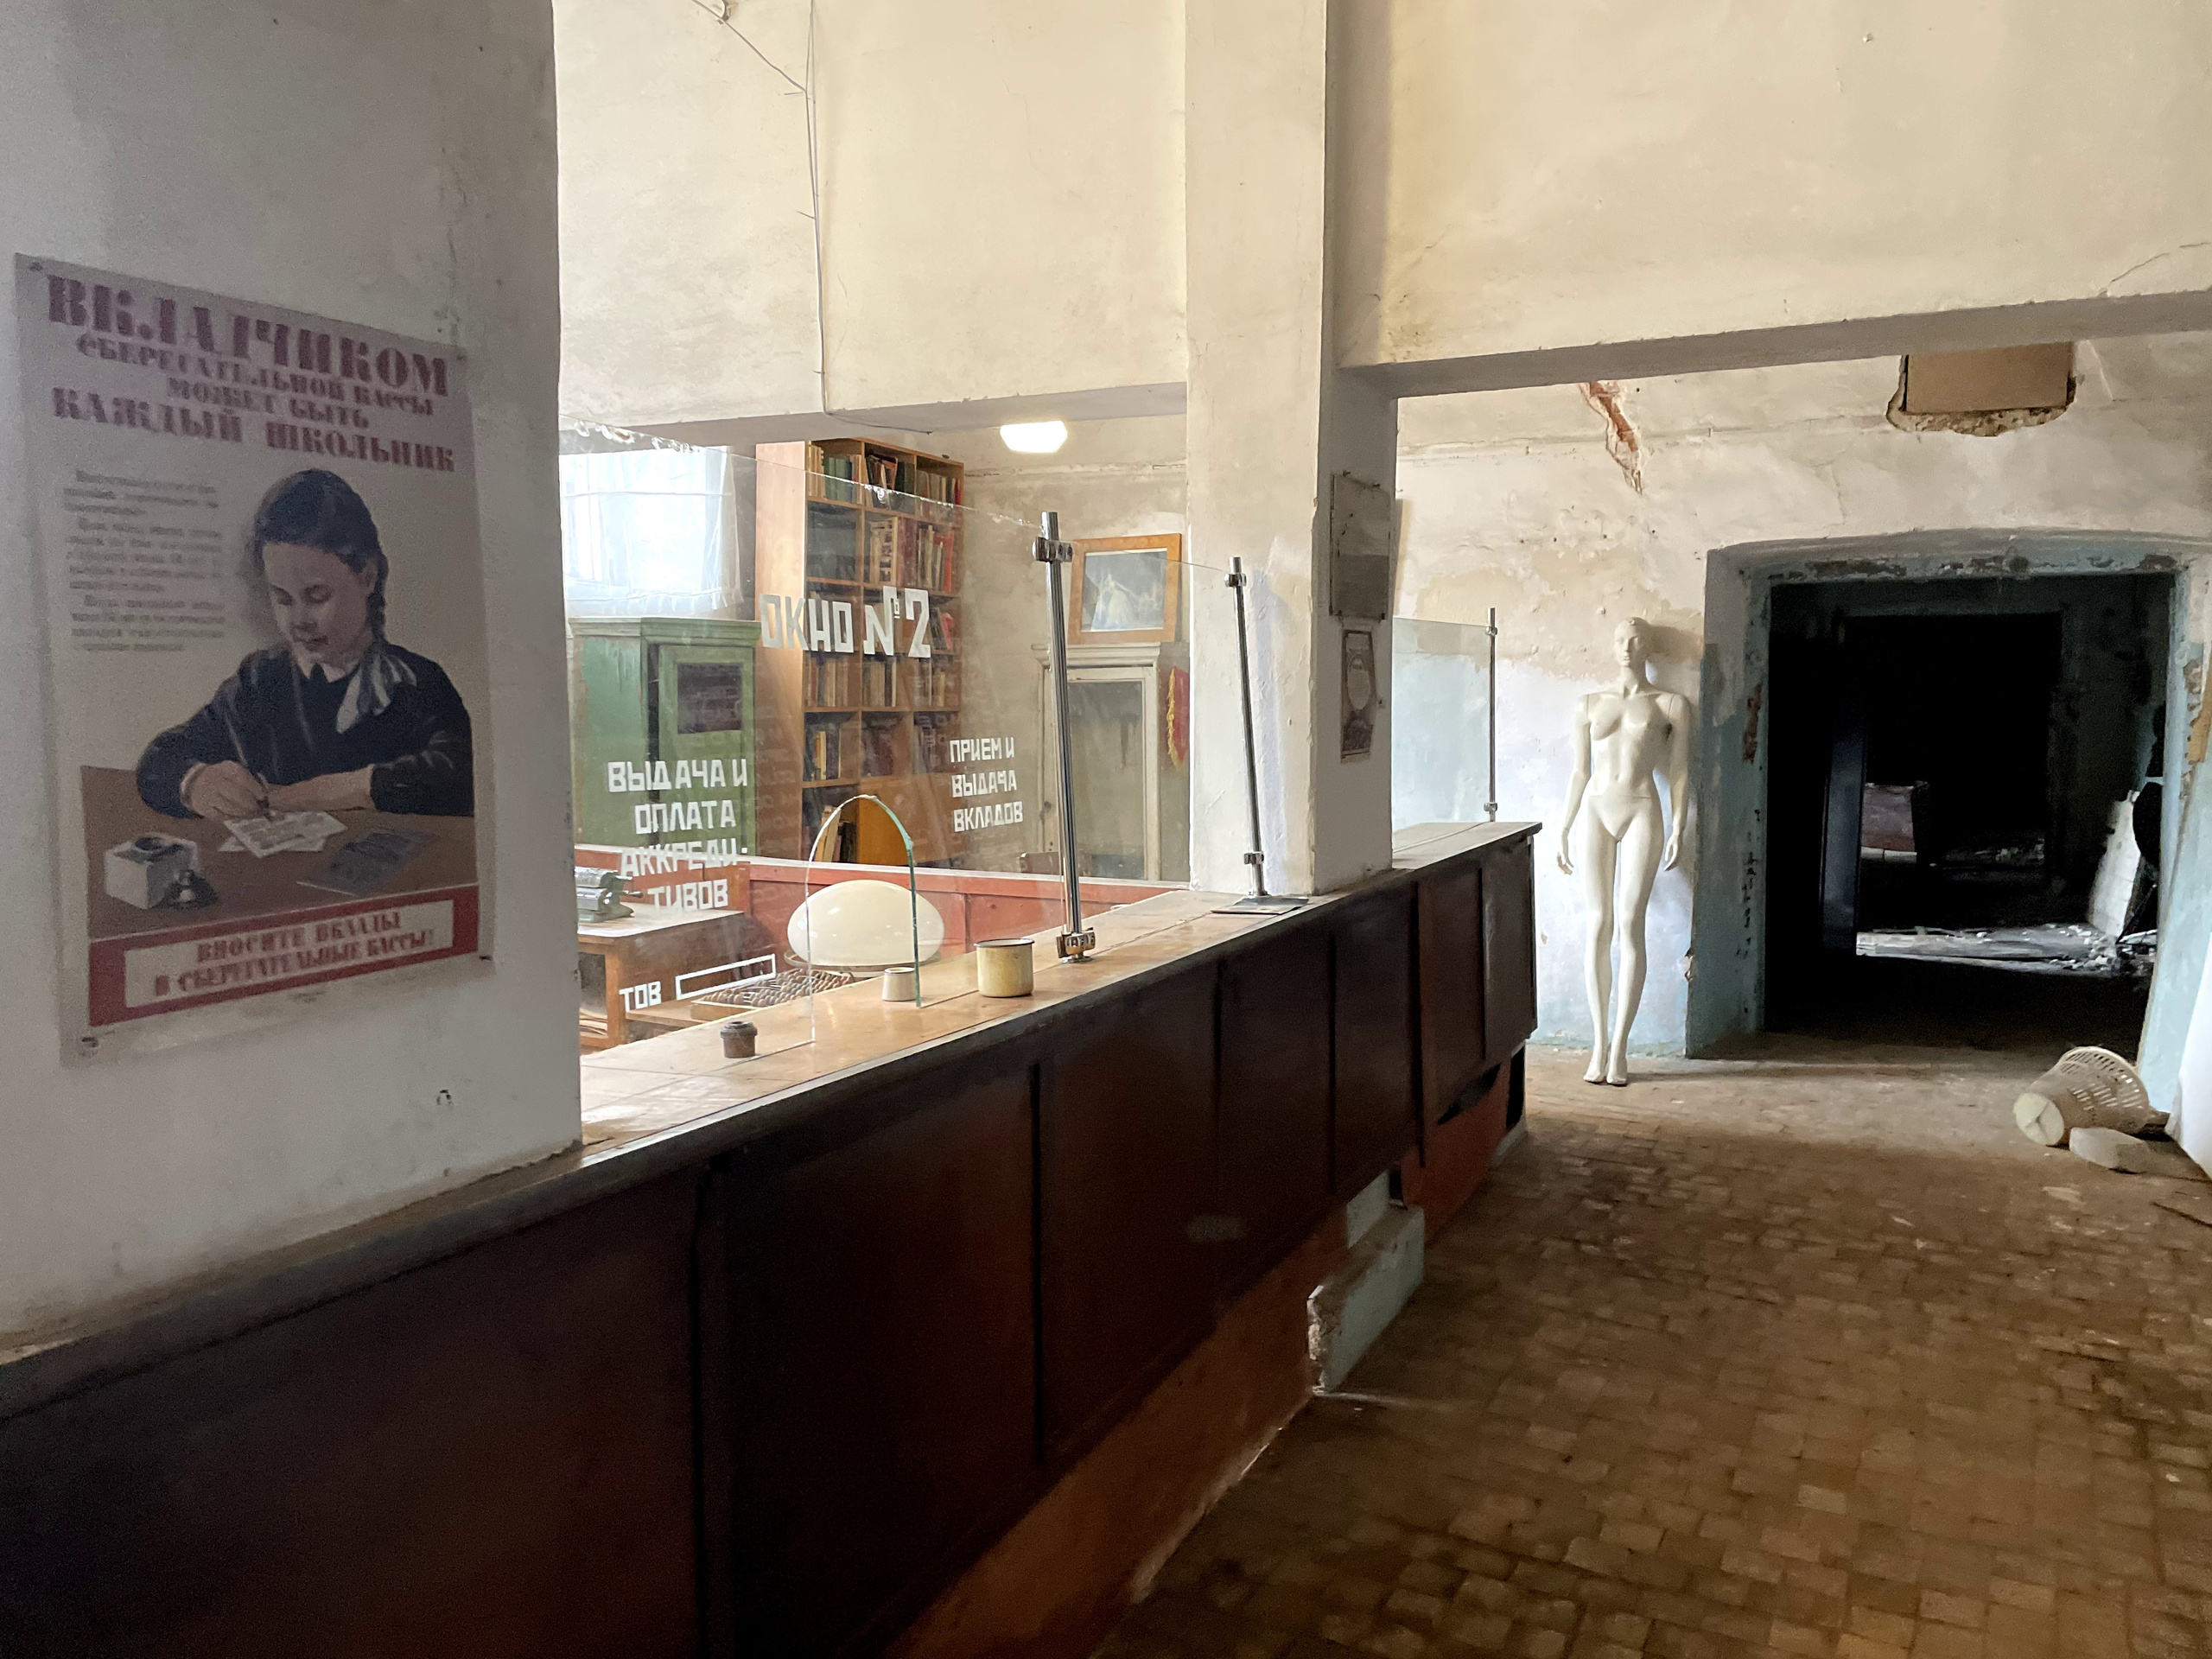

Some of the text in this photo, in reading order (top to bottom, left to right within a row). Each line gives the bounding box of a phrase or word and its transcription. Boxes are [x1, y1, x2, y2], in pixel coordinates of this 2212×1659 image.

[266, 422, 454, 472] ШКОЛЬНИК
[758, 594, 855, 653] ОКНО
[950, 735, 1015, 763] ПРИЕМ И
[607, 758, 748, 792] ВЫДАЧА И
[951, 770, 1017, 798] ВЫДАЧА
[634, 799, 737, 835] ОПЛАТА
[953, 800, 1024, 832] ВКЛАДОВ
[647, 879, 728, 912] ТИВОВ
[619, 981, 662, 1013] ТОВ
